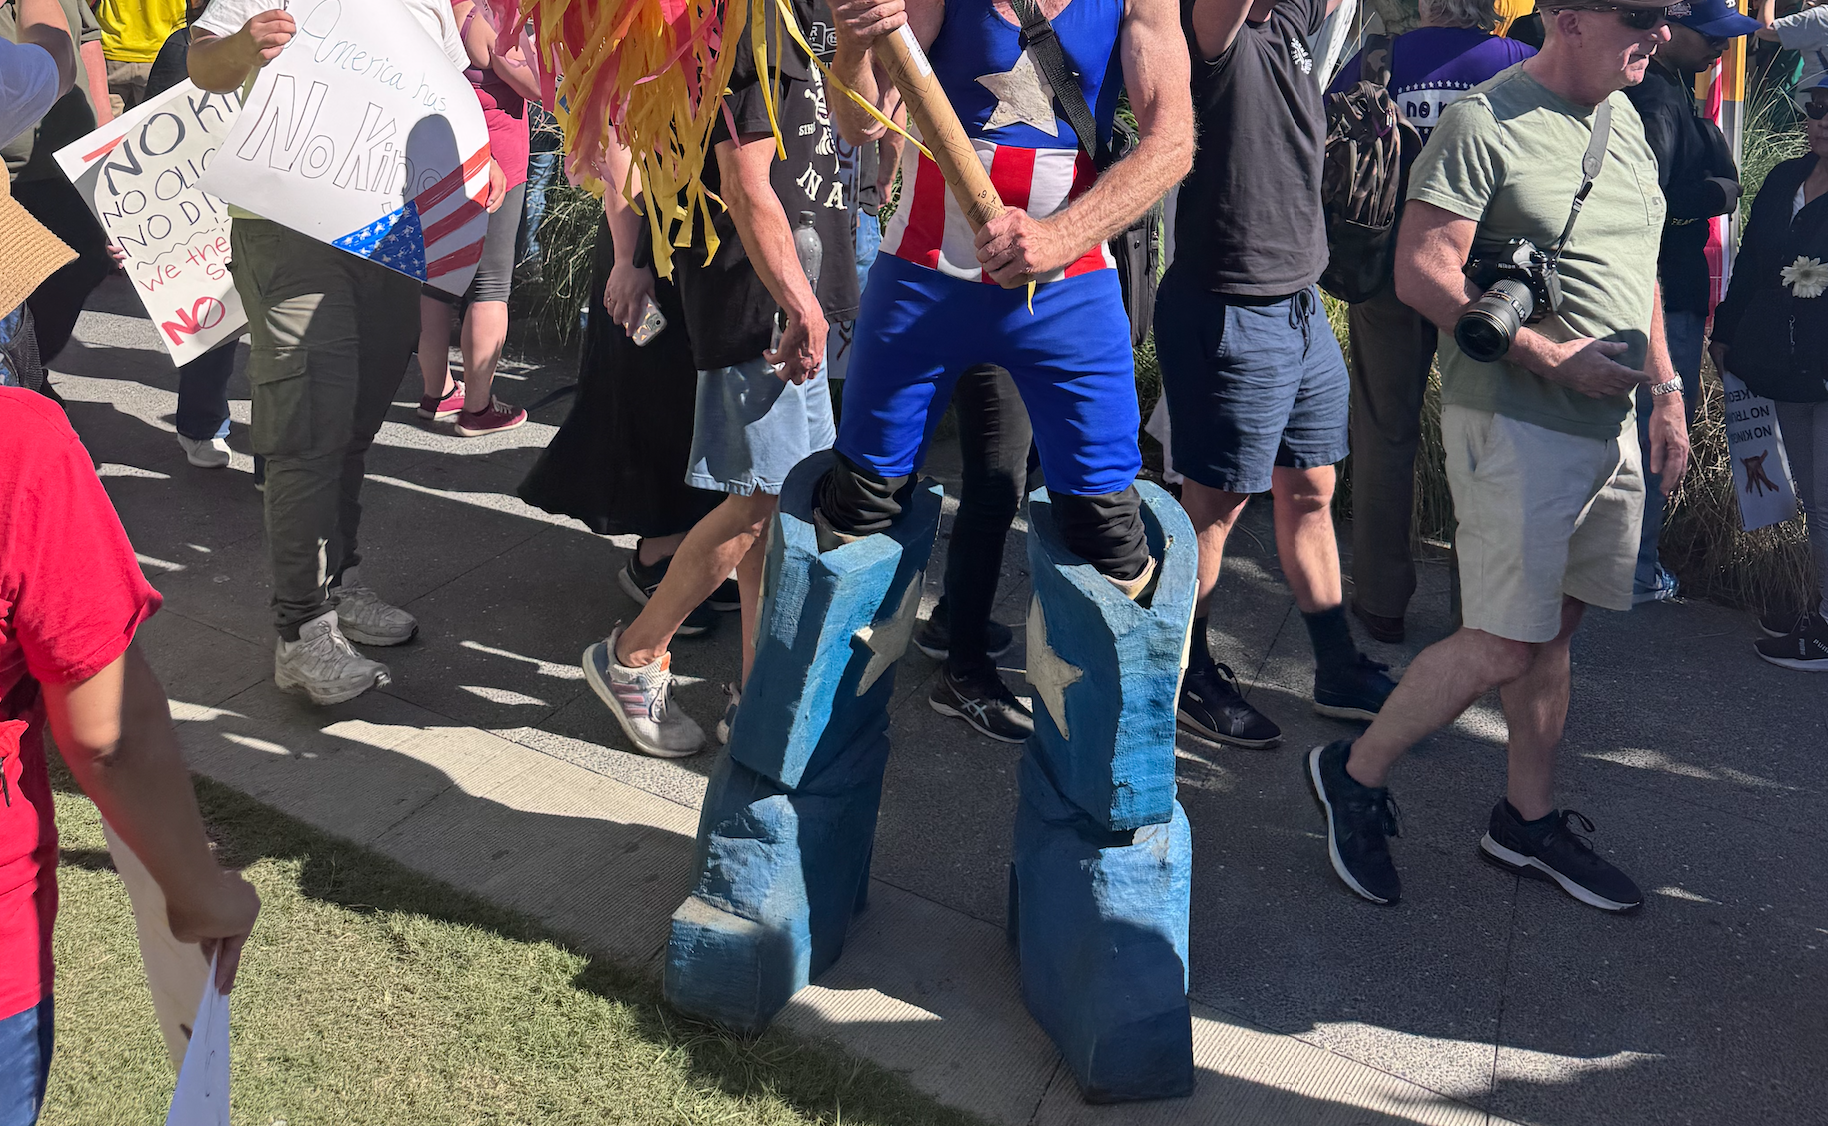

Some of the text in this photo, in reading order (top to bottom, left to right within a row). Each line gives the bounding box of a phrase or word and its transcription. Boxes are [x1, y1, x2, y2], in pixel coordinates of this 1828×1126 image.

[236, 73, 335, 179] No
[104, 112, 186, 197] NO
[103, 190, 147, 228] NO
[117, 214, 172, 258] NO
[185, 236, 231, 267] the
[161, 296, 226, 346] NO
[1750, 405, 1770, 419] NO
[1753, 425, 1772, 439] NO
